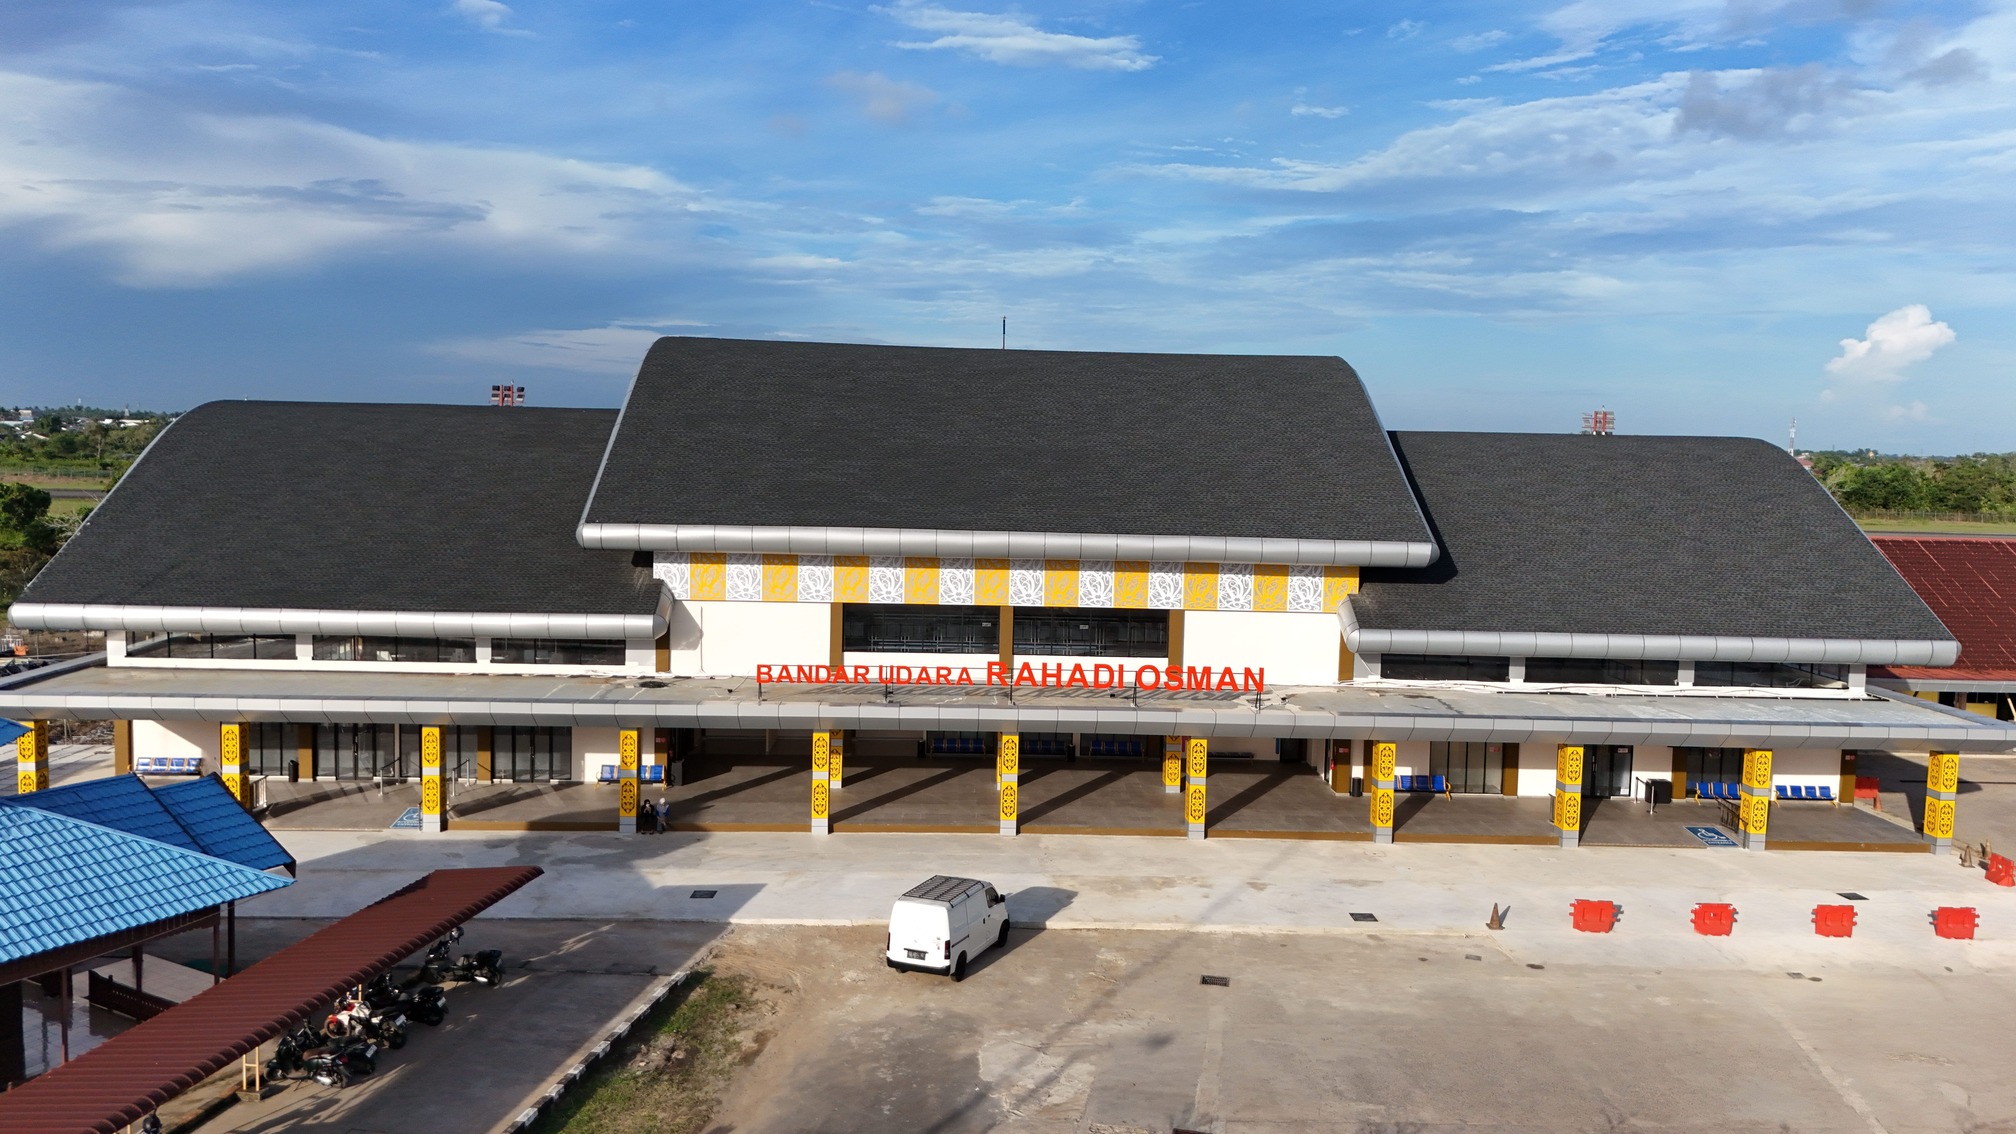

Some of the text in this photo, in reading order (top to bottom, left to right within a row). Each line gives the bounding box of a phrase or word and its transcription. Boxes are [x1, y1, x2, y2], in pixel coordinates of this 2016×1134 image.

[756, 661, 1265, 693] BANDAR UDARA RAHADI OSMAN
